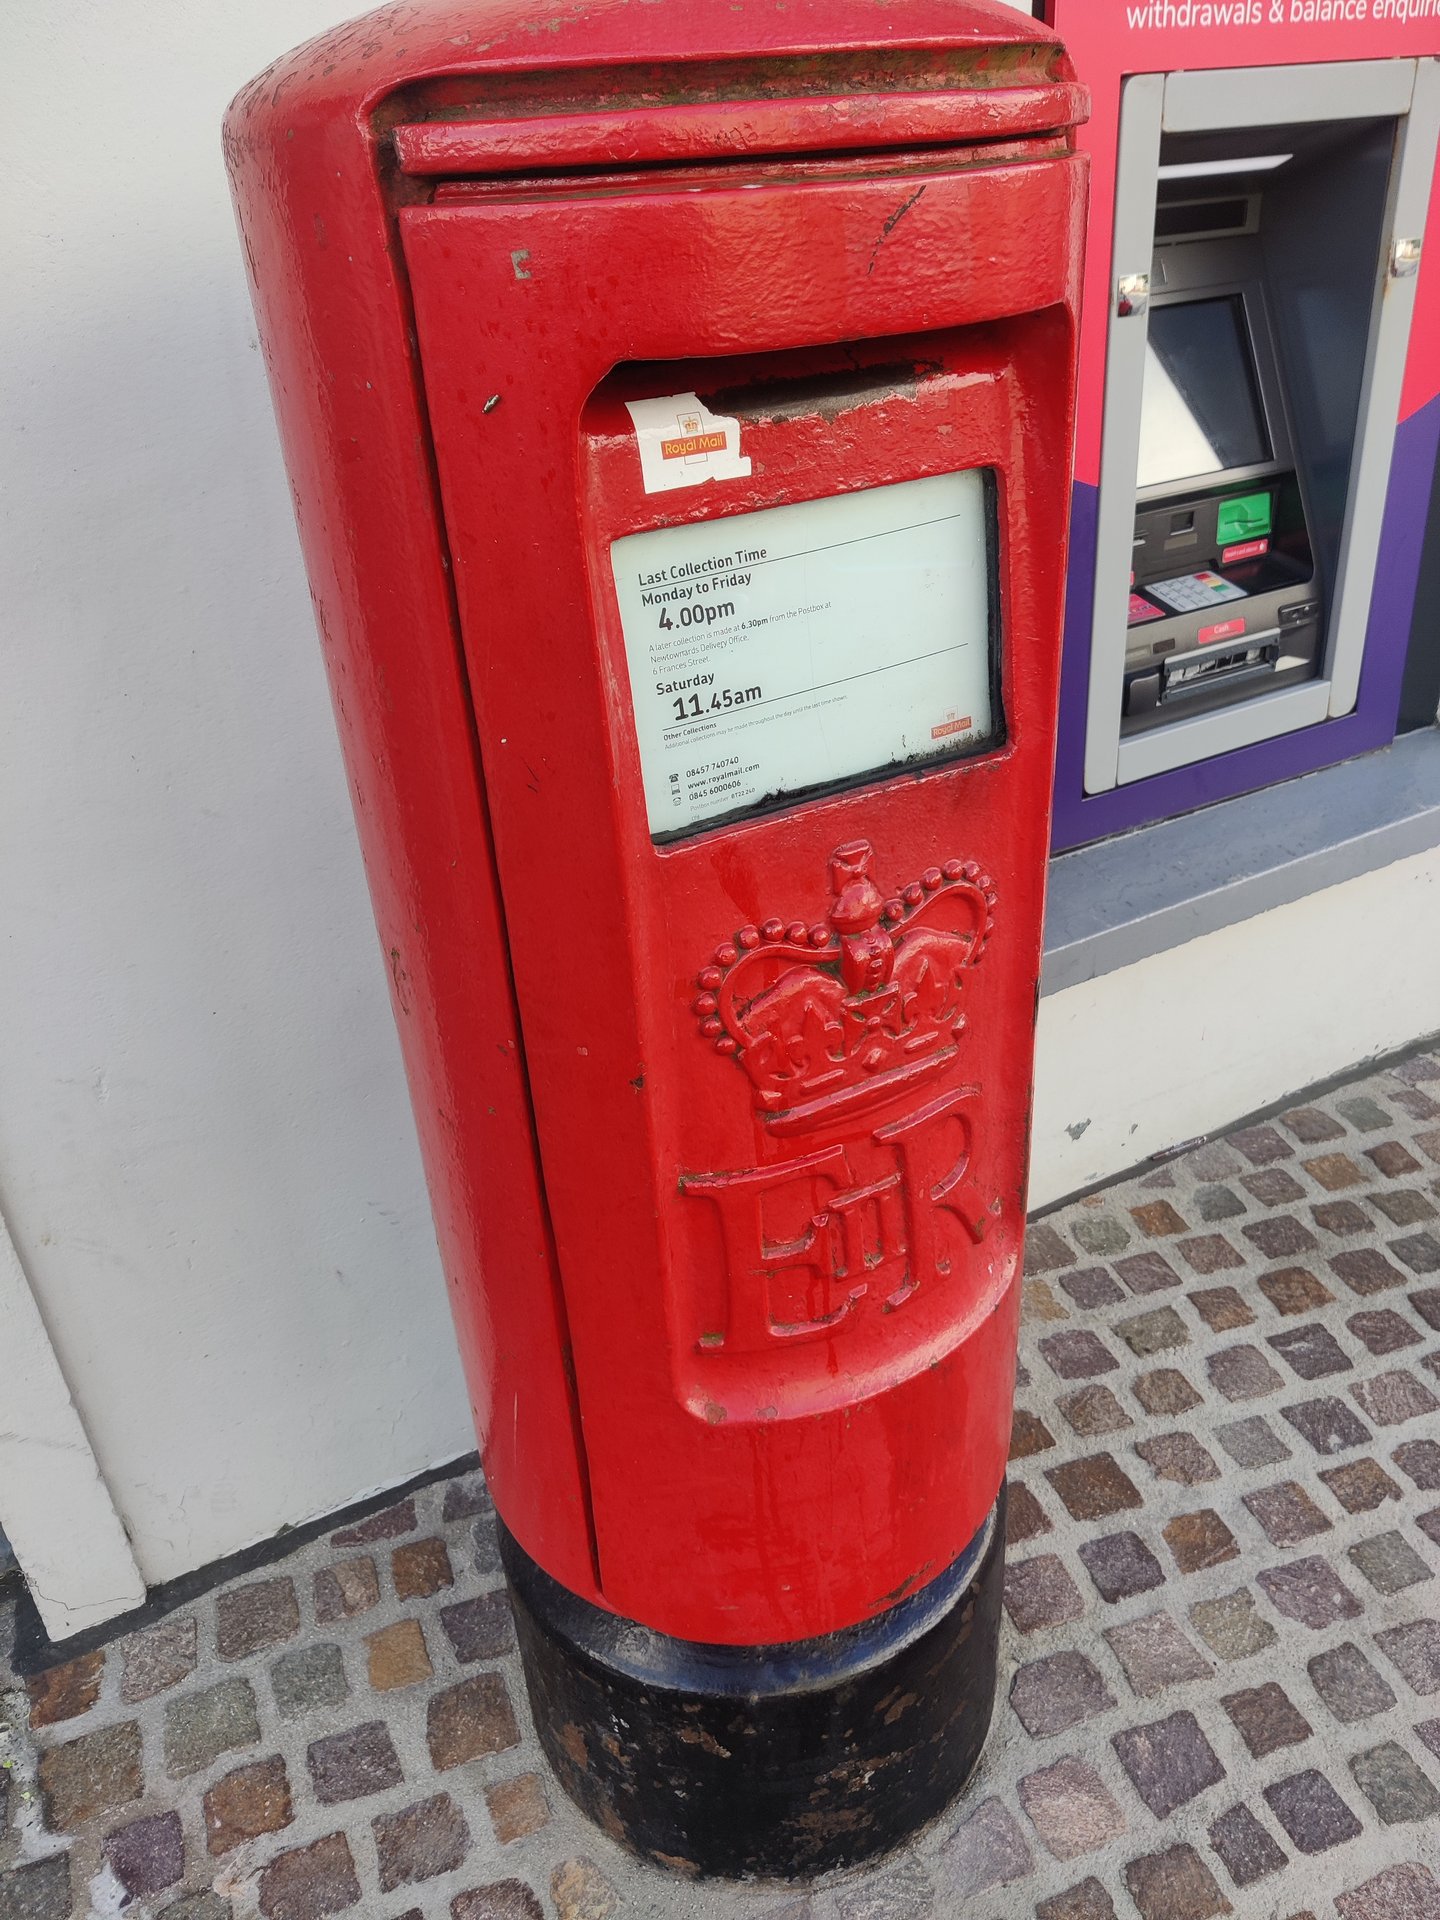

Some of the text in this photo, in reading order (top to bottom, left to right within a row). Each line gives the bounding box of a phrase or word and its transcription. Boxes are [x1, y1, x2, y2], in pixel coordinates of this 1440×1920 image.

[1126, 0, 1262, 29] withdrawals
[1268, 0, 1283, 23] &
[1289, 0, 1366, 23] balance
[665, 435, 723, 456] Royal Mail
[638, 549, 767, 586] Last Collection Time
[642, 573, 751, 607] Monday to Friday
[649, 601, 832, 652] A later collection is made at 6.30pm from the Postbox at
[658, 601, 735, 631] 4.00pm
[650, 646, 700, 664] Newtownards
[700, 639, 727, 652] Delivery
[652, 667, 658, 676] 6
[658, 661, 687, 675] Frances
[656, 673, 714, 695] Saturday
[672, 686, 762, 721] 11.45am
[663, 722, 717, 741] Other Collections
[691, 731, 716, 743] collections
[933, 718, 971, 736] Royal Mail
[686, 756, 739, 778] 08457 740740
[688, 763, 760, 790] www.royalmail.com
[689, 779, 742, 801] 0845 6000606
